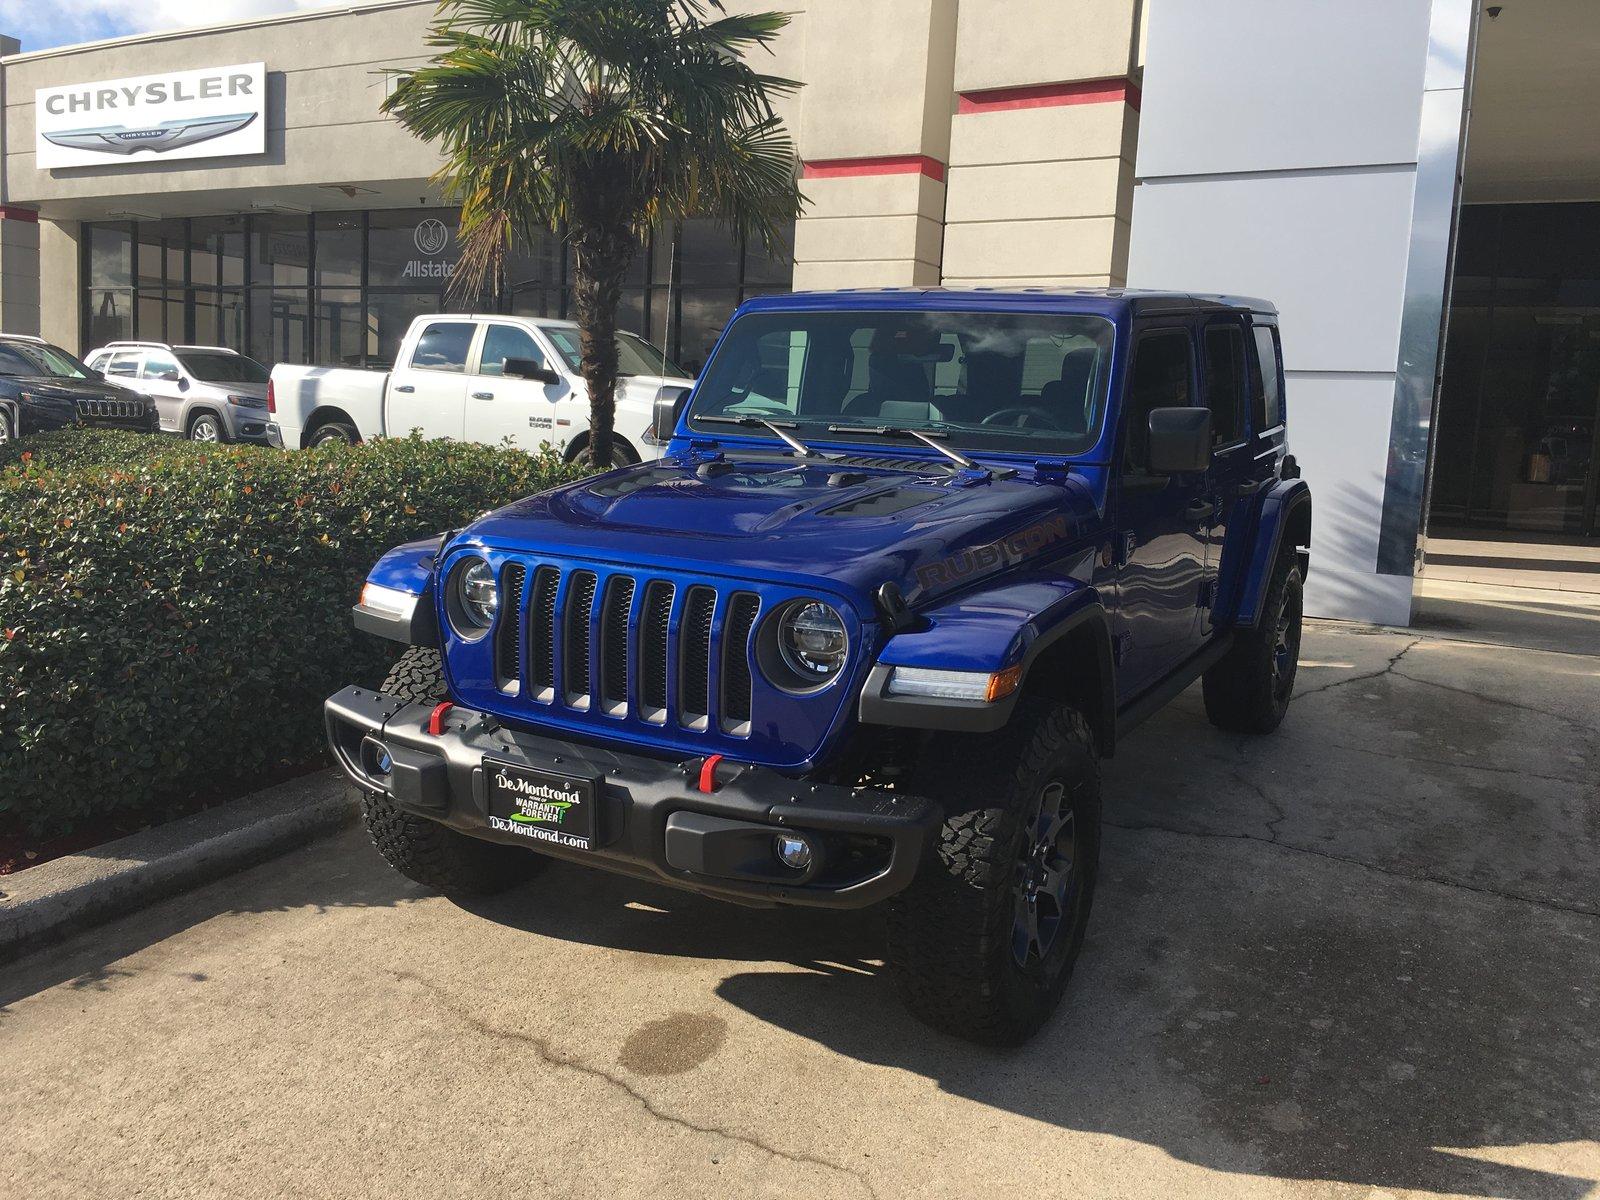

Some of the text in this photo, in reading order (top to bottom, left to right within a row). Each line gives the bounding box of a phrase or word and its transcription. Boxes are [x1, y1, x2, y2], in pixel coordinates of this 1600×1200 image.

[45, 74, 253, 115] CHRYSLER
[120, 130, 162, 139] CHRYSLER
[401, 260, 456, 278] Allstate
[915, 516, 1067, 591] RUBICON
[495, 774, 580, 804] DeMontrond
[515, 797, 560, 814] WARRANTY
[489, 815, 589, 850] DeMontrond.com
